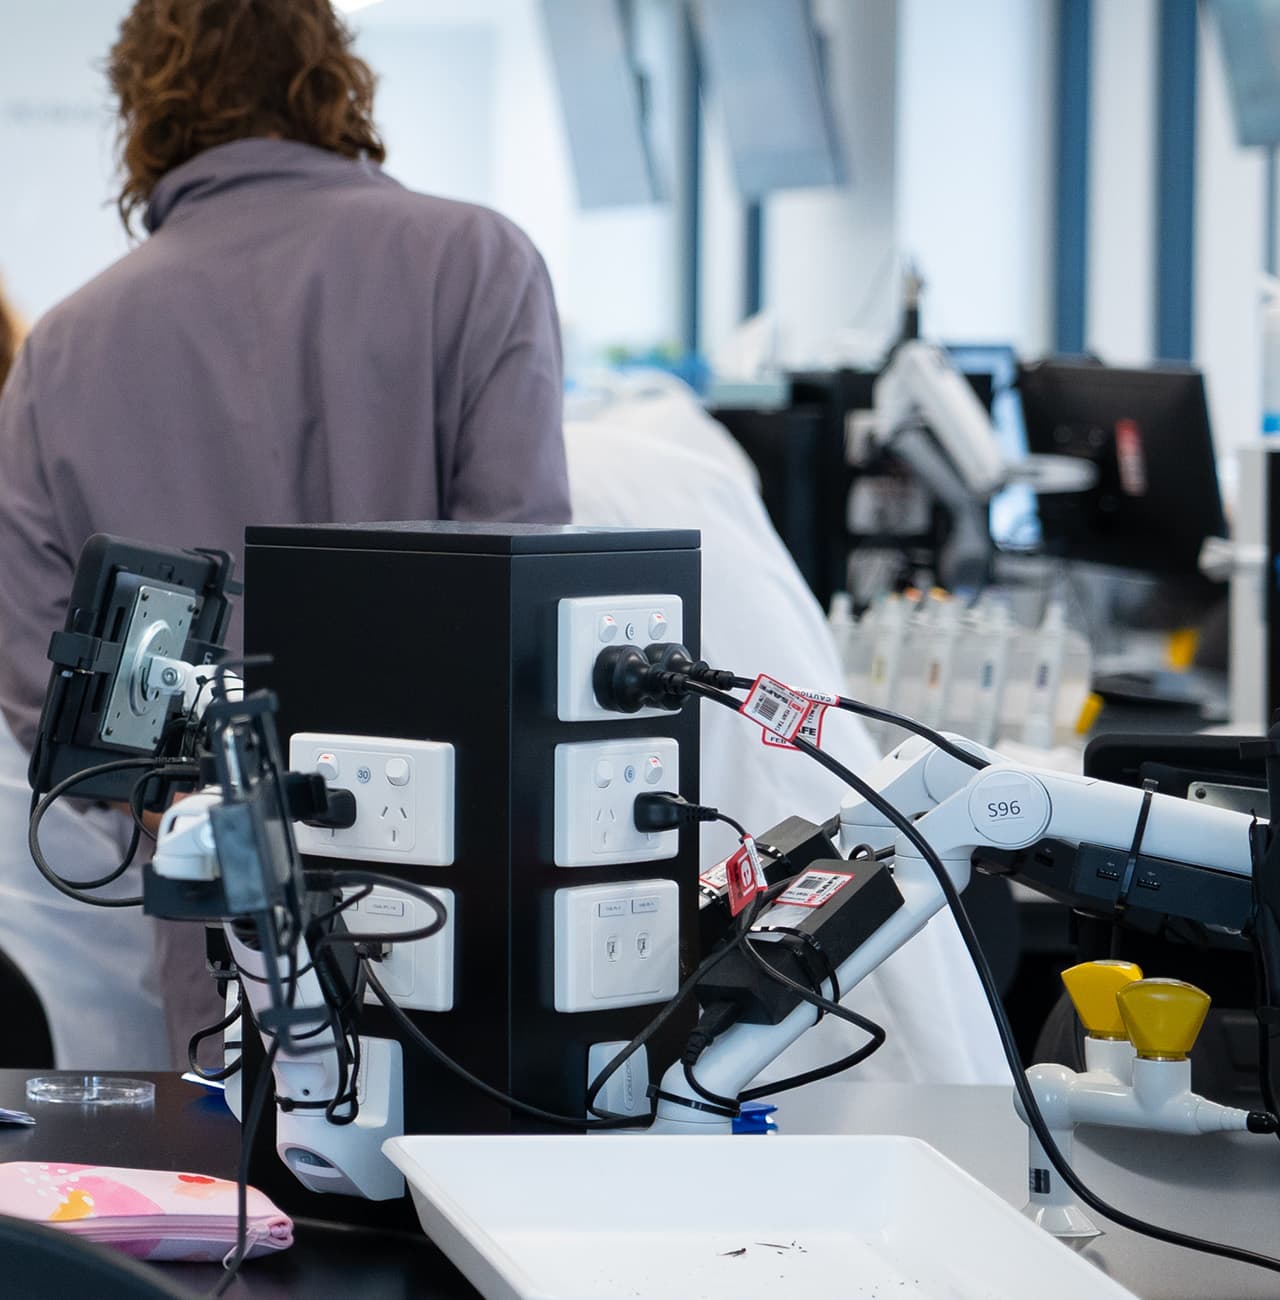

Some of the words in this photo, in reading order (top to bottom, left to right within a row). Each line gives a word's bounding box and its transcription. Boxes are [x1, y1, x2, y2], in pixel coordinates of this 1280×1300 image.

[759, 684, 789, 704] SAFE
[358, 769, 369, 780] 30
[987, 800, 1021, 818] S96
